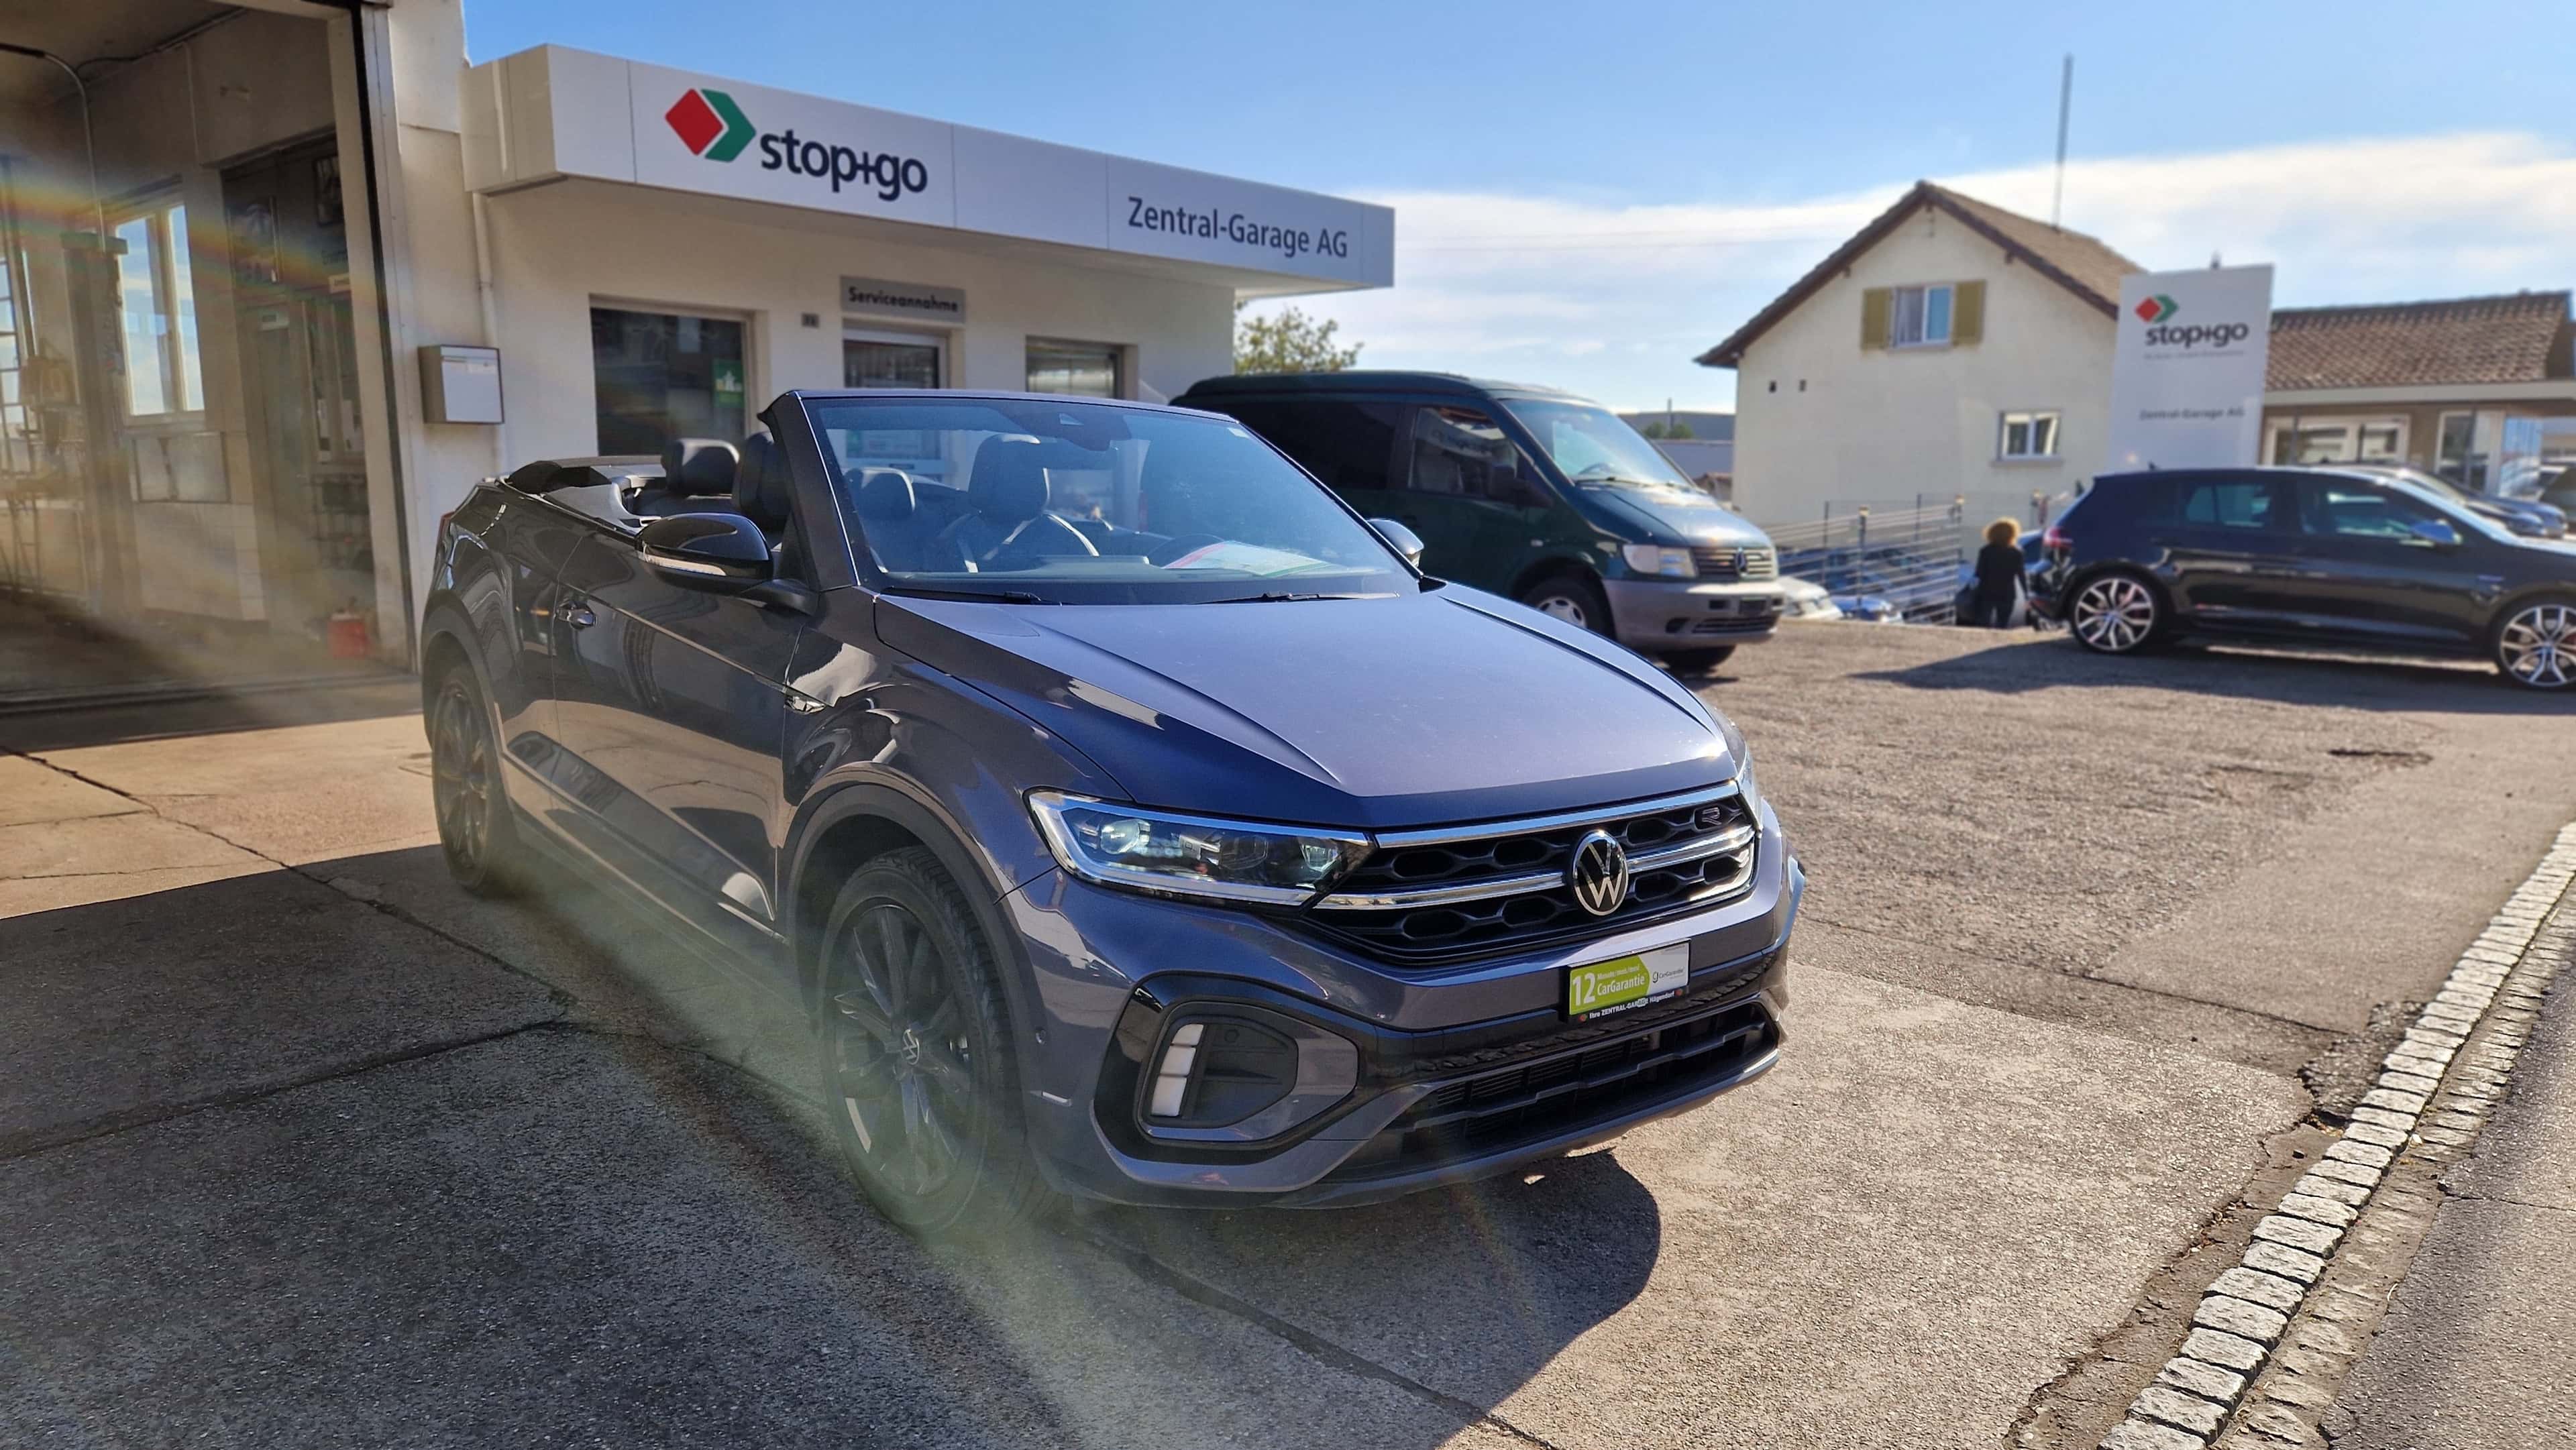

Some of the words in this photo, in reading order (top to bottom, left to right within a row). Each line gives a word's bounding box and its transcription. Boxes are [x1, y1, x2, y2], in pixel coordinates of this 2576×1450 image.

[759, 128, 928, 202] stop+go
[1128, 196, 1310, 258] Zentral-Garage
[1316, 228, 1348, 258] AG
[848, 285, 959, 312] Serviceannahme
[2144, 322, 2250, 349] stop+go
[1572, 972, 1596, 1006] 12
[1597, 972, 1646, 996] CarGarantie
